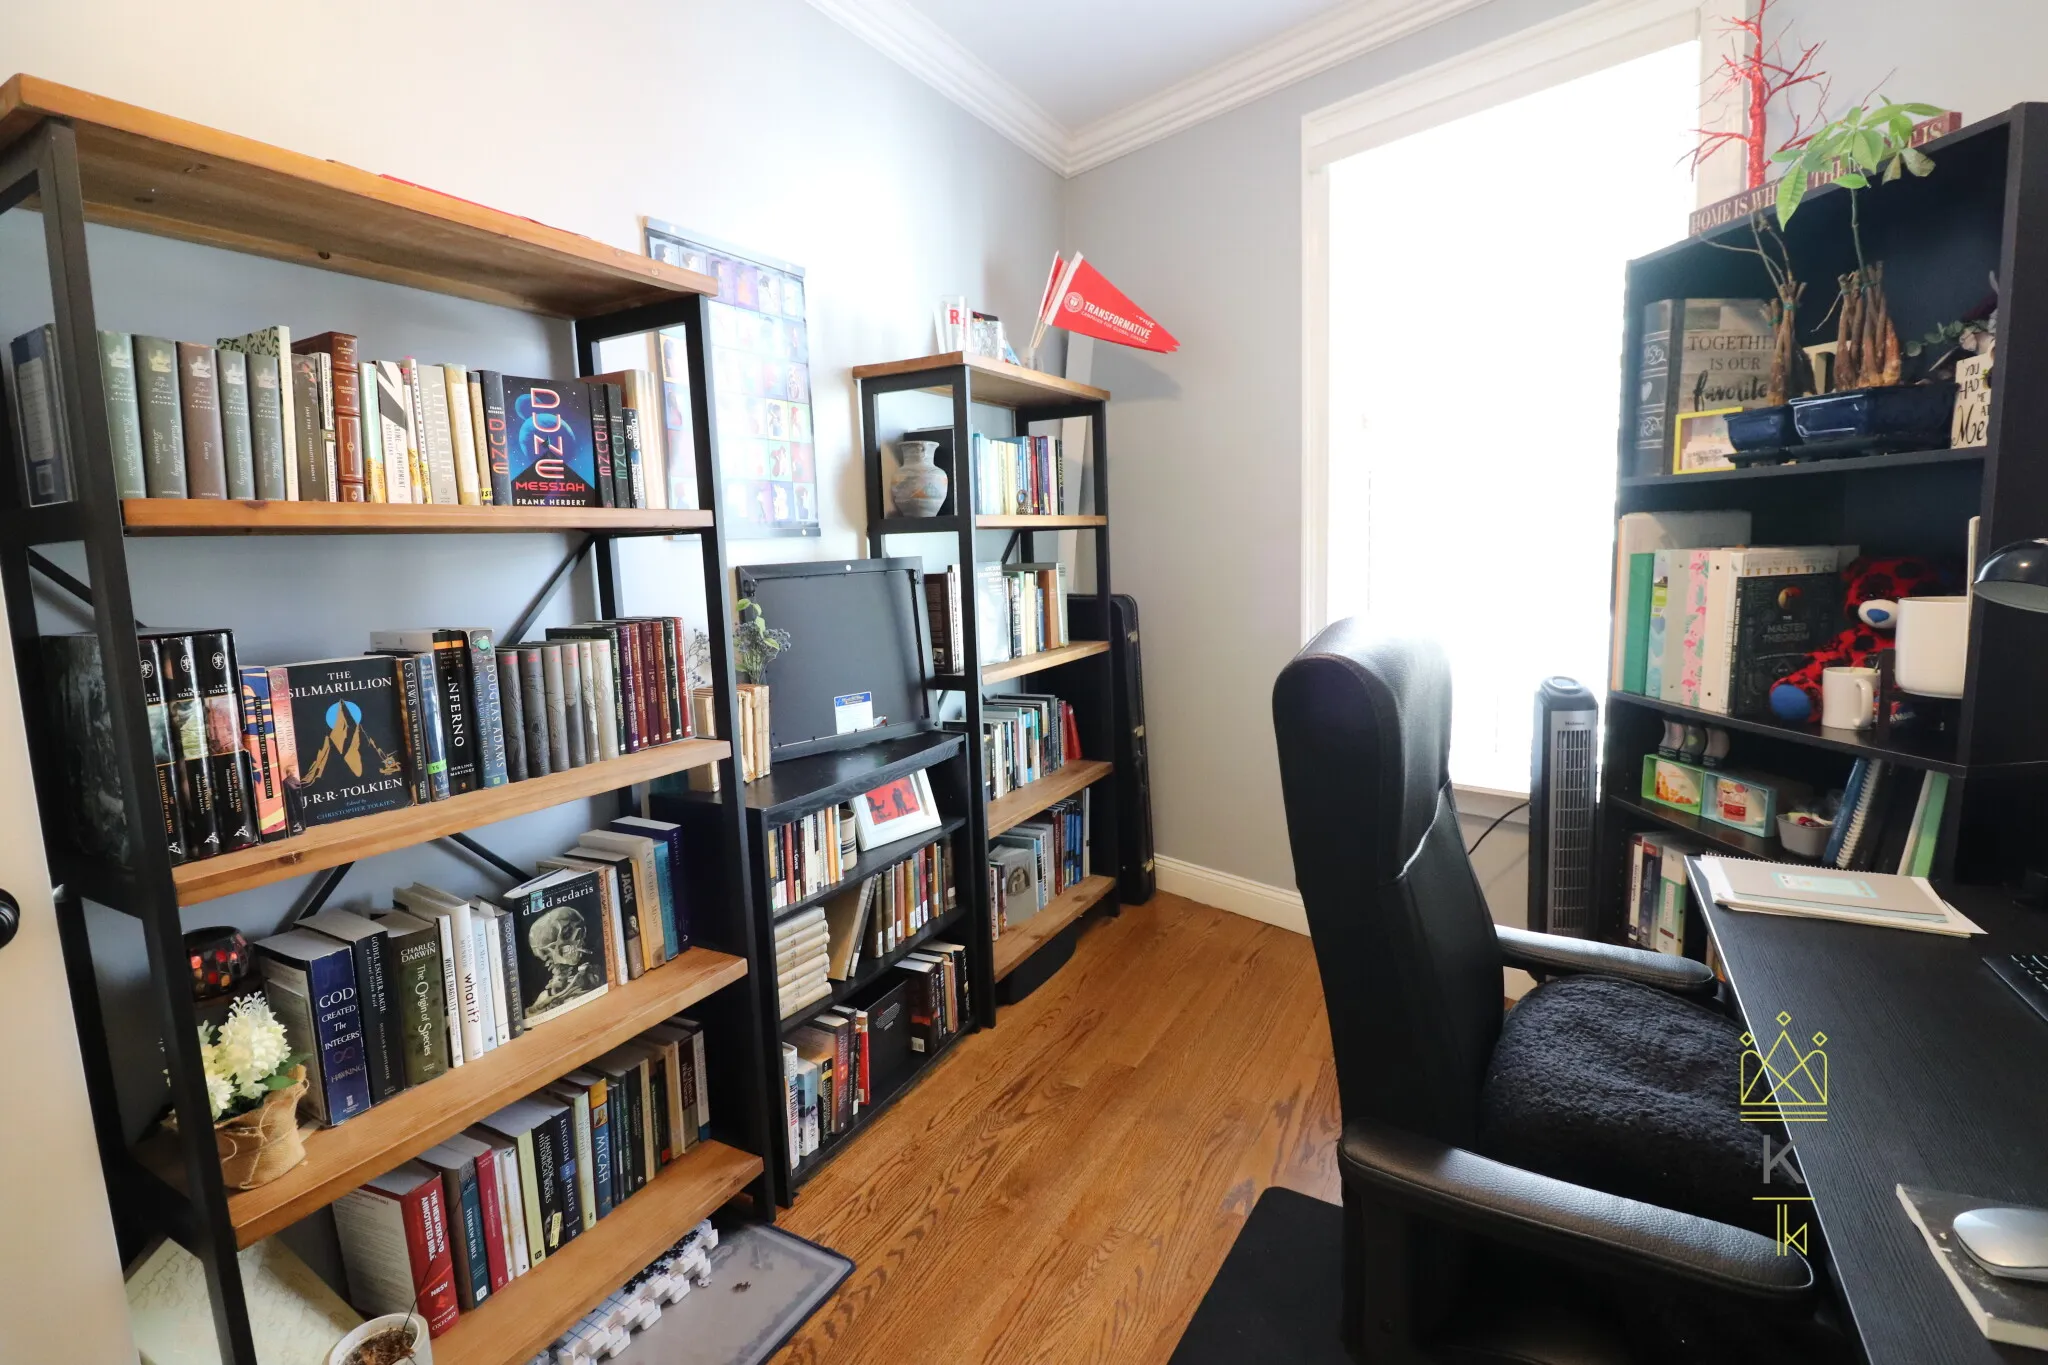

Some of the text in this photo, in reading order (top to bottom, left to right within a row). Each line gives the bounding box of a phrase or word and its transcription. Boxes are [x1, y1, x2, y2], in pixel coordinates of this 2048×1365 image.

[1691, 202, 1732, 234] HOME
[1734, 197, 1748, 220] IS
[1081, 310, 1104, 325] CAMPAIGN
[1112, 324, 1129, 337] GLOBAL
[1130, 332, 1148, 344] CHANGE
[1084, 301, 1152, 339] TRANSFORMATIVE
[1710, 357, 1761, 370] IS OUR
[1965, 362, 1980, 376] YOU
[1693, 370, 1768, 412] favorite
[1960, 378, 1980, 399] HAD
[1977, 392, 1986, 402] ME
[432, 393, 450, 446] LITTLE
[530, 387, 565, 479] DUNE
[489, 418, 510, 474] DUNE
[595, 431, 612, 478] DUNE
[612, 434, 628, 480] DUNE
[396, 453, 405, 488] PUNISHMENT
[440, 451, 452, 482] LIFE
[515, 481, 586, 492] MESSIAH
[1762, 632, 1810, 643] THEOREM
[1767, 622, 1808, 633] MASTER
[288, 676, 392, 699] SILMARILLION
[327, 670, 352, 680] THE
[406, 680, 417, 706] LEWIS
[486, 664, 505, 768] DOUGLAS ADAMS
[450, 768, 474, 776] MARTINEZ
[340, 778, 403, 798] TOLKIEN
[316, 799, 396, 820] CHRISTOPHER TOLKIEN
[522, 898, 553, 916] did
[556, 884, 594, 905] sedaris
[621, 873, 634, 903] JACK
[504, 922, 512, 943] GOOD
[401, 941, 436, 956] CHARLES
[402, 948, 436, 963] DARWIN
[506, 945, 515, 967] GRIEF
[372, 963, 385, 994] ESCHER,
[444, 957, 457, 1012] WHITE FRAGILITY
[319, 987, 354, 1008] GOD
[414, 964, 436, 1057] The Origin of Species
[463, 973, 480, 1024] what if?
[510, 987, 520, 1021] BARTELS
[322, 1004, 356, 1023] CREATED
[334, 1021, 348, 1033] The
[325, 1030, 361, 1050] INTEGERS
[331, 1064, 366, 1083] HAWKING
[556, 1118, 573, 1162] KINGDOM
[574, 1122, 590, 1161] PROPHETS
[536, 1133, 553, 1204] HISTORICAL BOOKS
[542, 1135, 557, 1178] HANDBOOK
[593, 1135, 611, 1184] MICAH
[563, 1178, 577, 1212] PRIESTS
[419, 1196, 437, 1261] ANNOTATED BIBLE
[429, 1189, 445, 1253] THE NEW OXFORD
[464, 1207, 479, 1260] HEBREW BIBLE
[431, 1282, 448, 1296] NRSV
[432, 1312, 456, 1331] OXFORD
